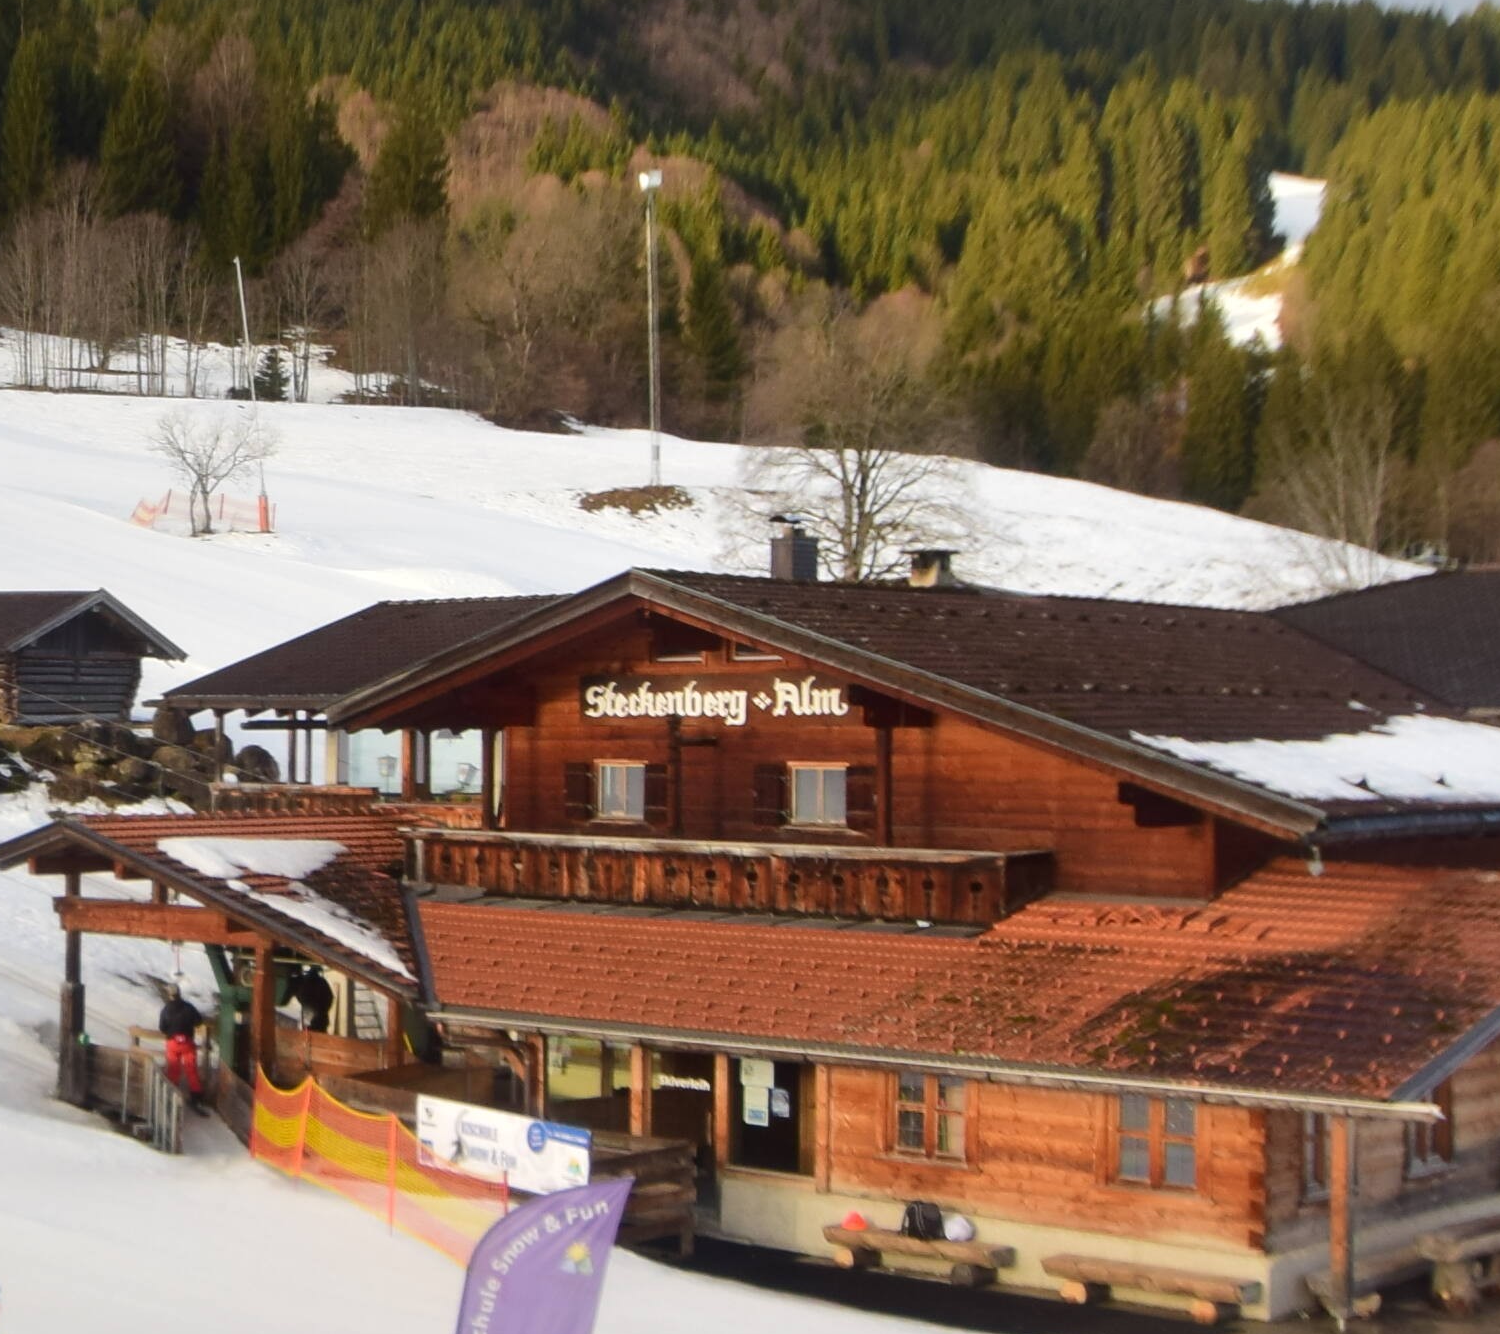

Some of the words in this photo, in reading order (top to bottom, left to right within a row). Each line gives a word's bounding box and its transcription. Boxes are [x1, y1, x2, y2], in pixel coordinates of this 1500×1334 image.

[585, 680, 748, 726] Steckenberg
[772, 675, 849, 717] Alm
[490, 1226, 540, 1276] Snow
[543, 1214, 562, 1234] &
[564, 1200, 609, 1225] Fun
